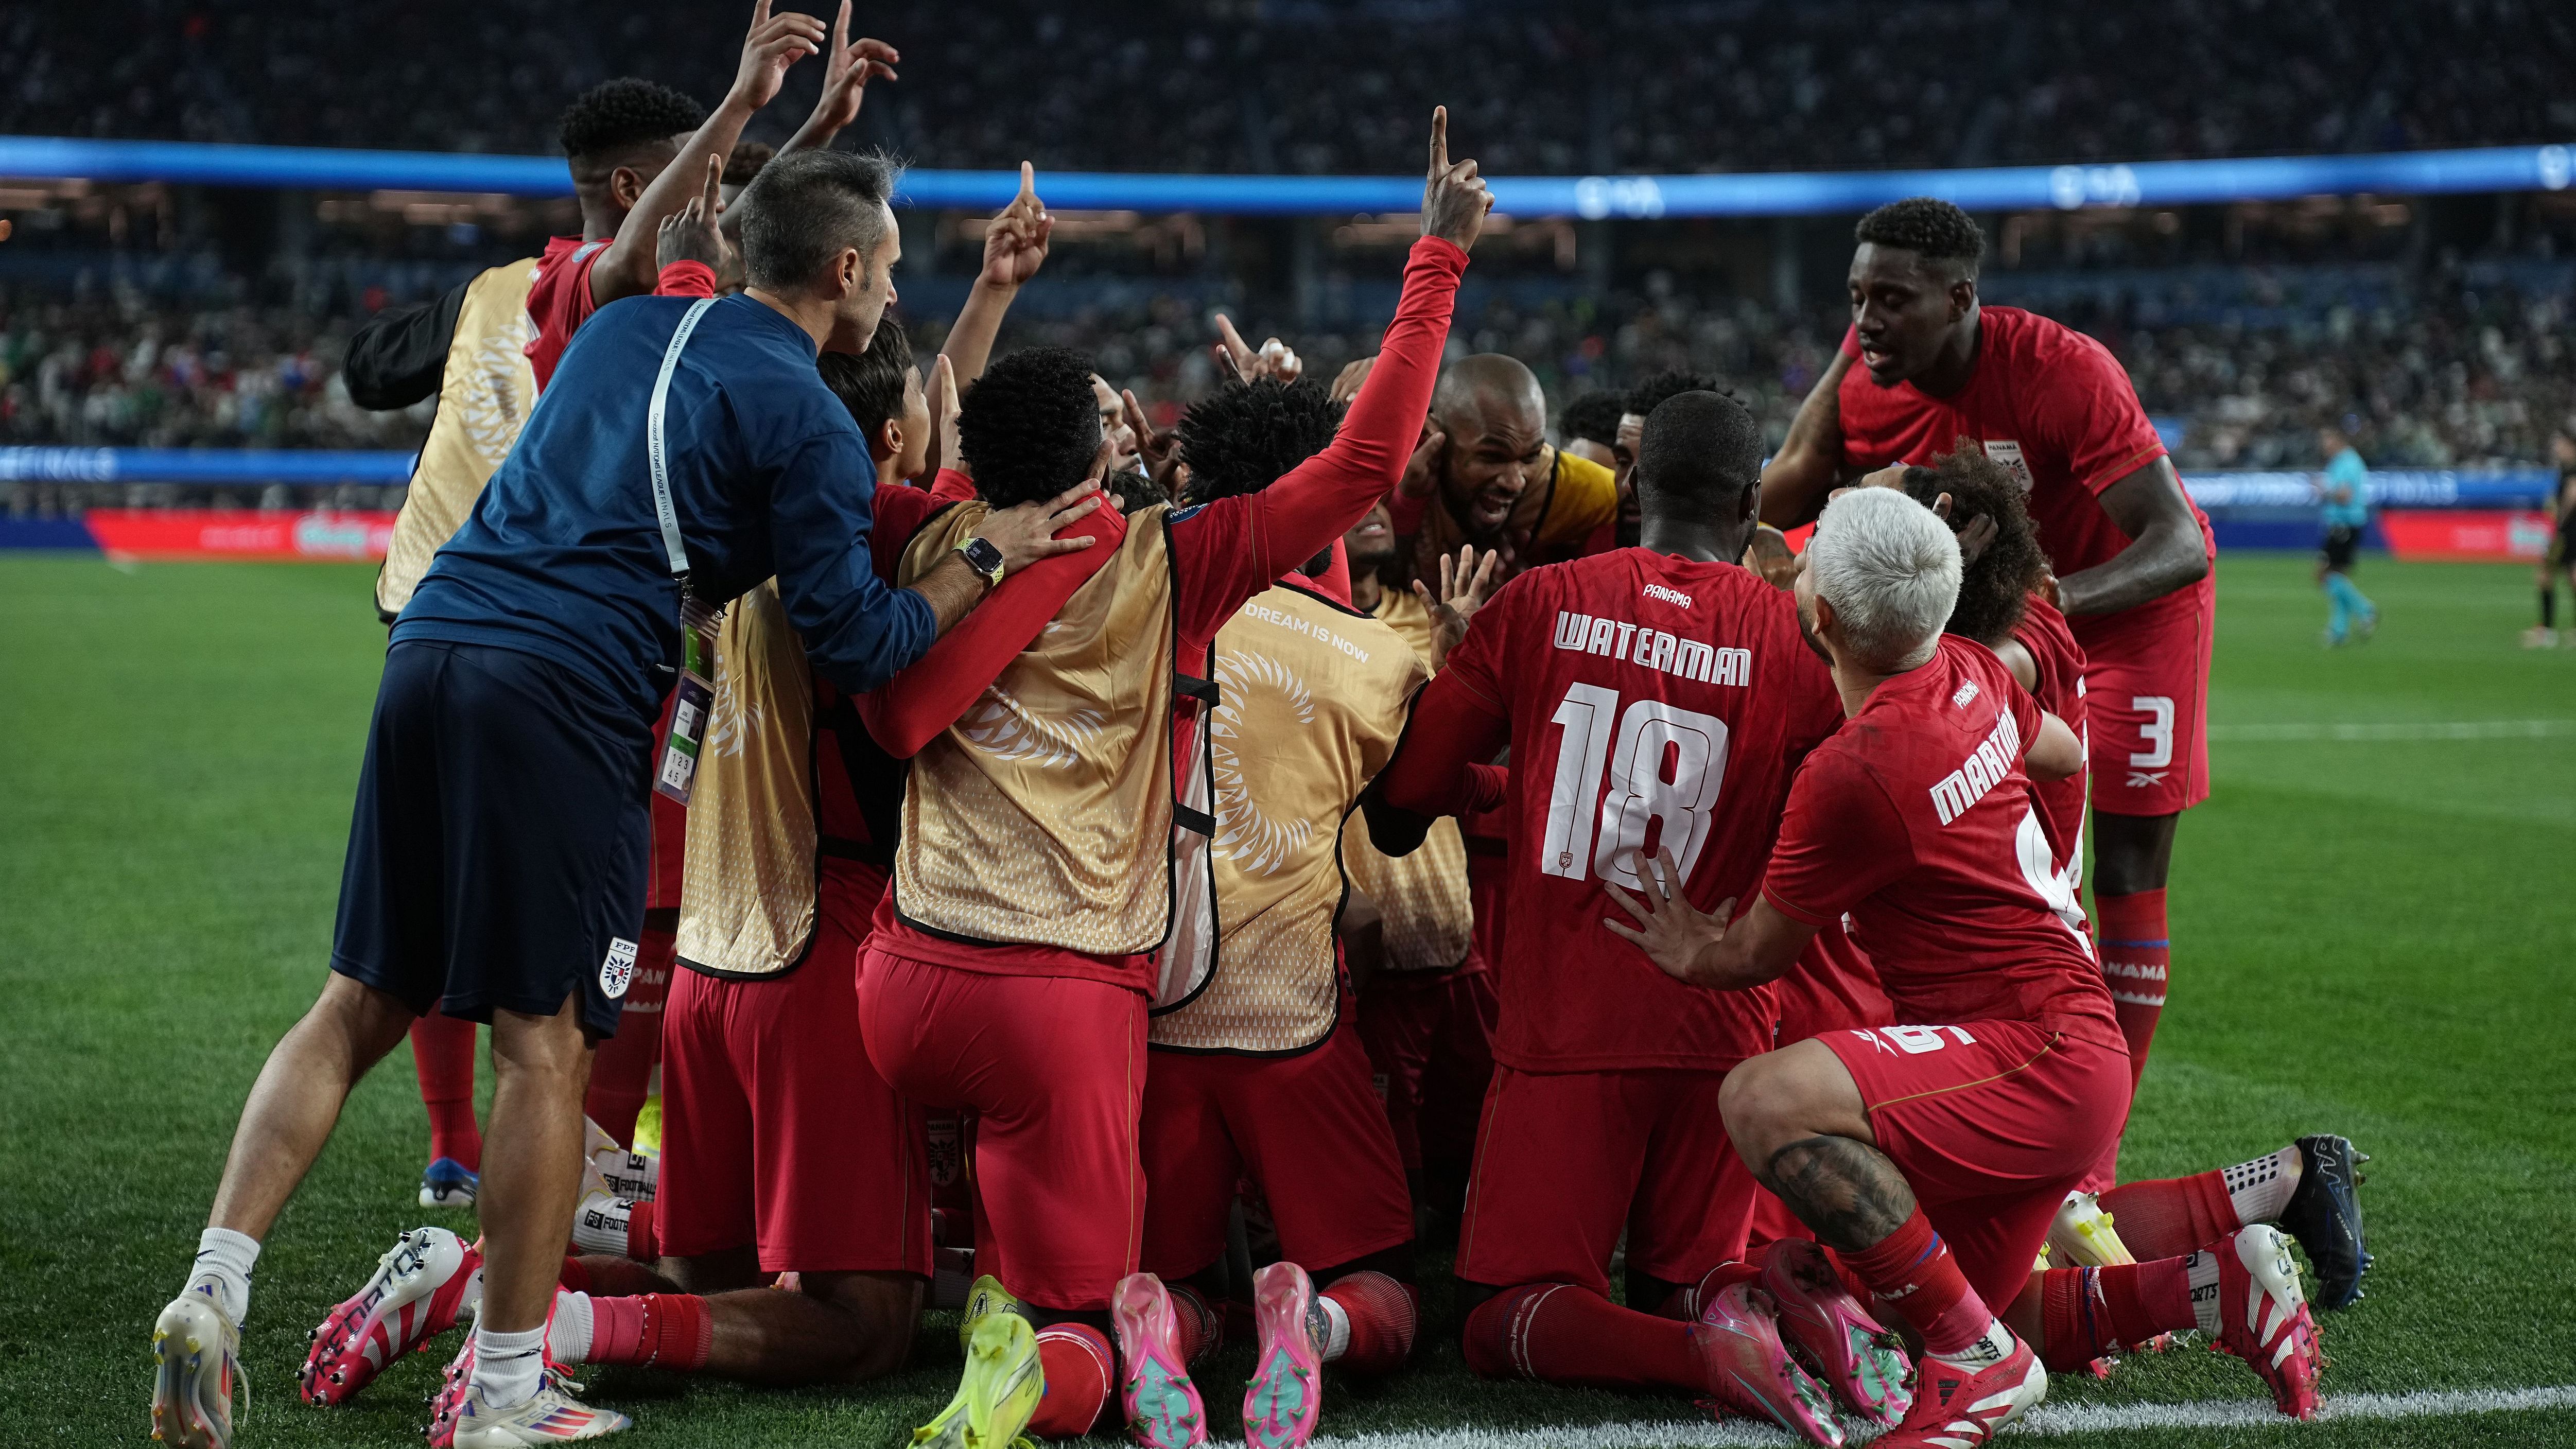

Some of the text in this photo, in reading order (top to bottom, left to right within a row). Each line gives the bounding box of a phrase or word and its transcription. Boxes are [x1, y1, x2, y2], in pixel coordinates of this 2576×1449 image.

[655, 470, 665, 496] LEAGUE
[659, 496, 672, 528] FINALS
[1244, 602, 1369, 664] DREAM IS NOW
[1554, 611, 1751, 687] WATERMAN
[2130, 696, 2174, 767] 3
[674, 772, 679, 782] 5
[677, 756, 683, 766] 2
[684, 759, 689, 770] 3
[1542, 682, 1729, 899] 18
[587, 1212, 601, 1228] FS
